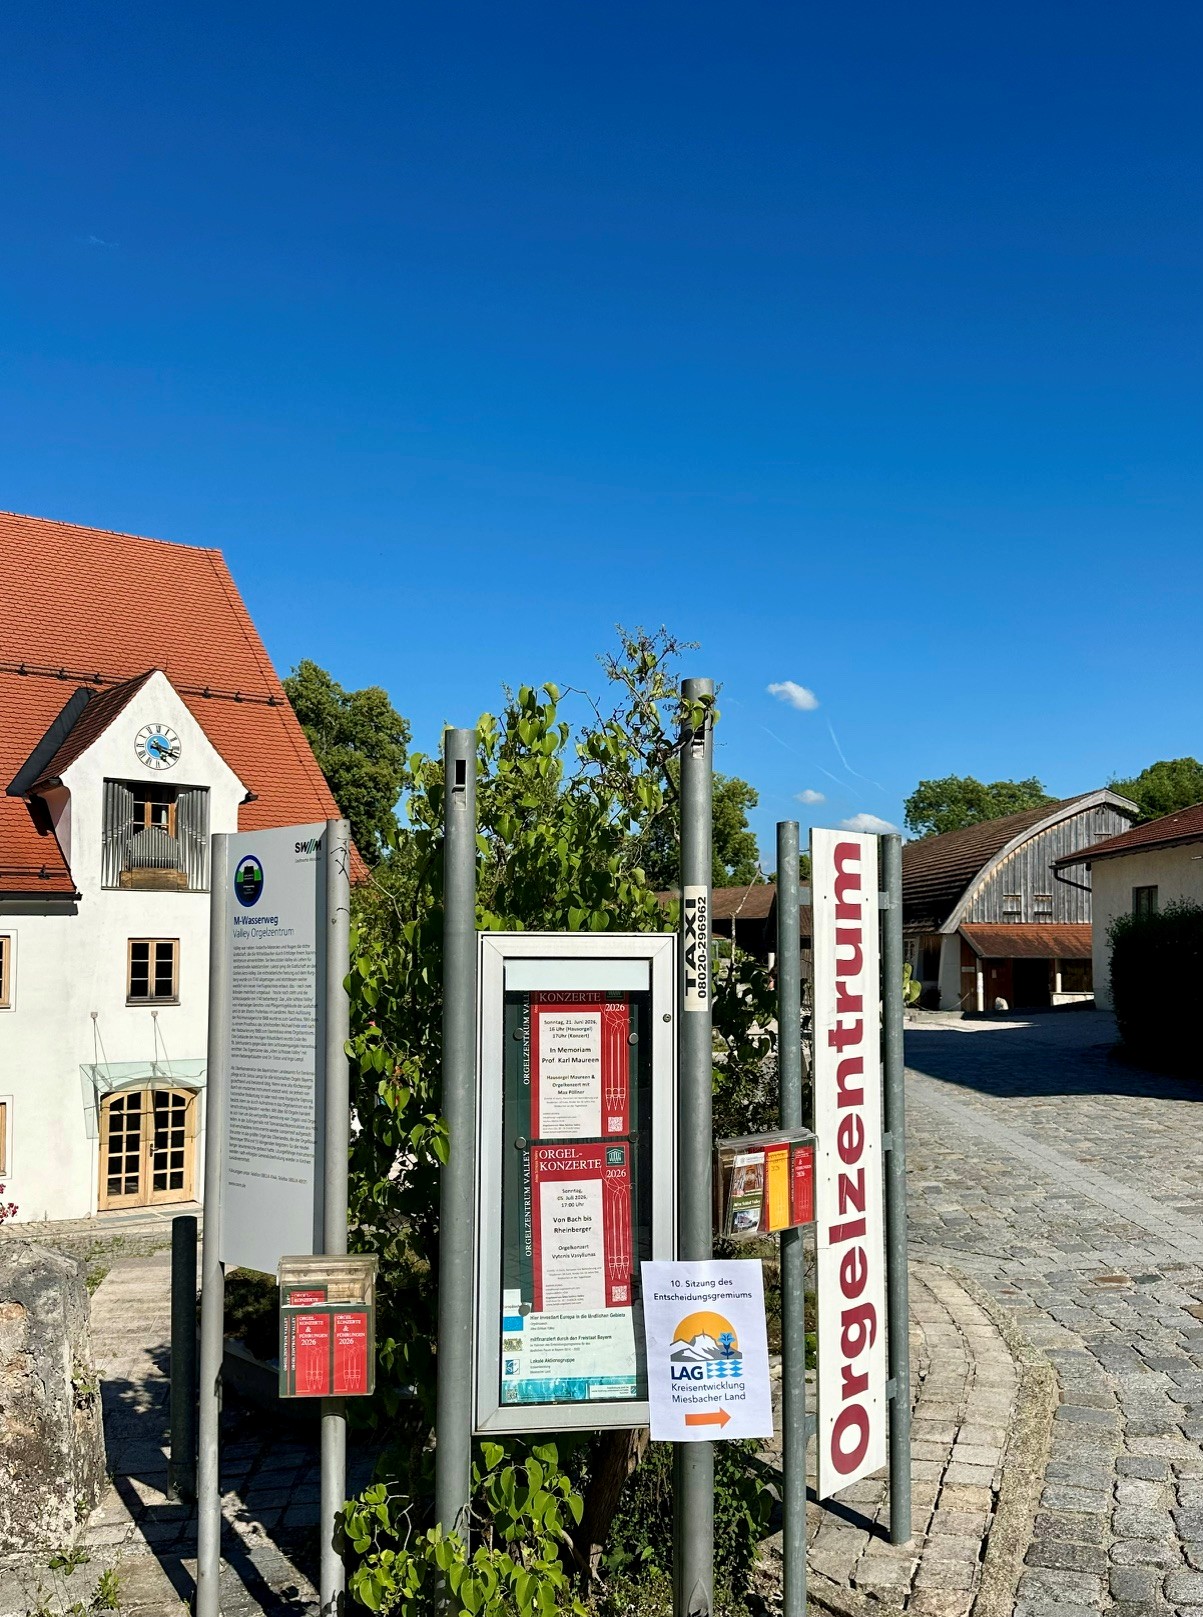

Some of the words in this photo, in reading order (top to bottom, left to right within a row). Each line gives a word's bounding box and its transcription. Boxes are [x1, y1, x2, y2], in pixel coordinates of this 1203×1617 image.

[234, 916, 278, 926] M-Wasserweg
[233, 928, 250, 939] Valley
[251, 927, 294, 939] Orgelzentrum
[685, 899, 696, 996] TAXI
[698, 896, 706, 998] 08020-296962
[539, 992, 601, 1002] KONZERTE
[605, 1003, 625, 1012] 2026
[539, 1149, 583, 1159] ORGEL-
[829, 842, 876, 1474] Orgelzentrum
[540, 1159, 602, 1171] KONZERTE
[606, 1169, 626, 1178] 2026
[524, 1187, 532, 1257] ORGELZENTRUM
[554, 1226, 592, 1234] Rheinberger
[670, 1280, 683, 1288] 10.
[686, 1279, 716, 1288] Sitzung
[718, 1278, 733, 1286] des
[653, 1292, 752, 1302] Entscheidungsgremiums
[670, 1365, 703, 1381] LAG
[671, 1381, 745, 1392] Kreisentwicklung
[672, 1394, 723, 1404] Miesbacher
[724, 1392, 746, 1401] Land
